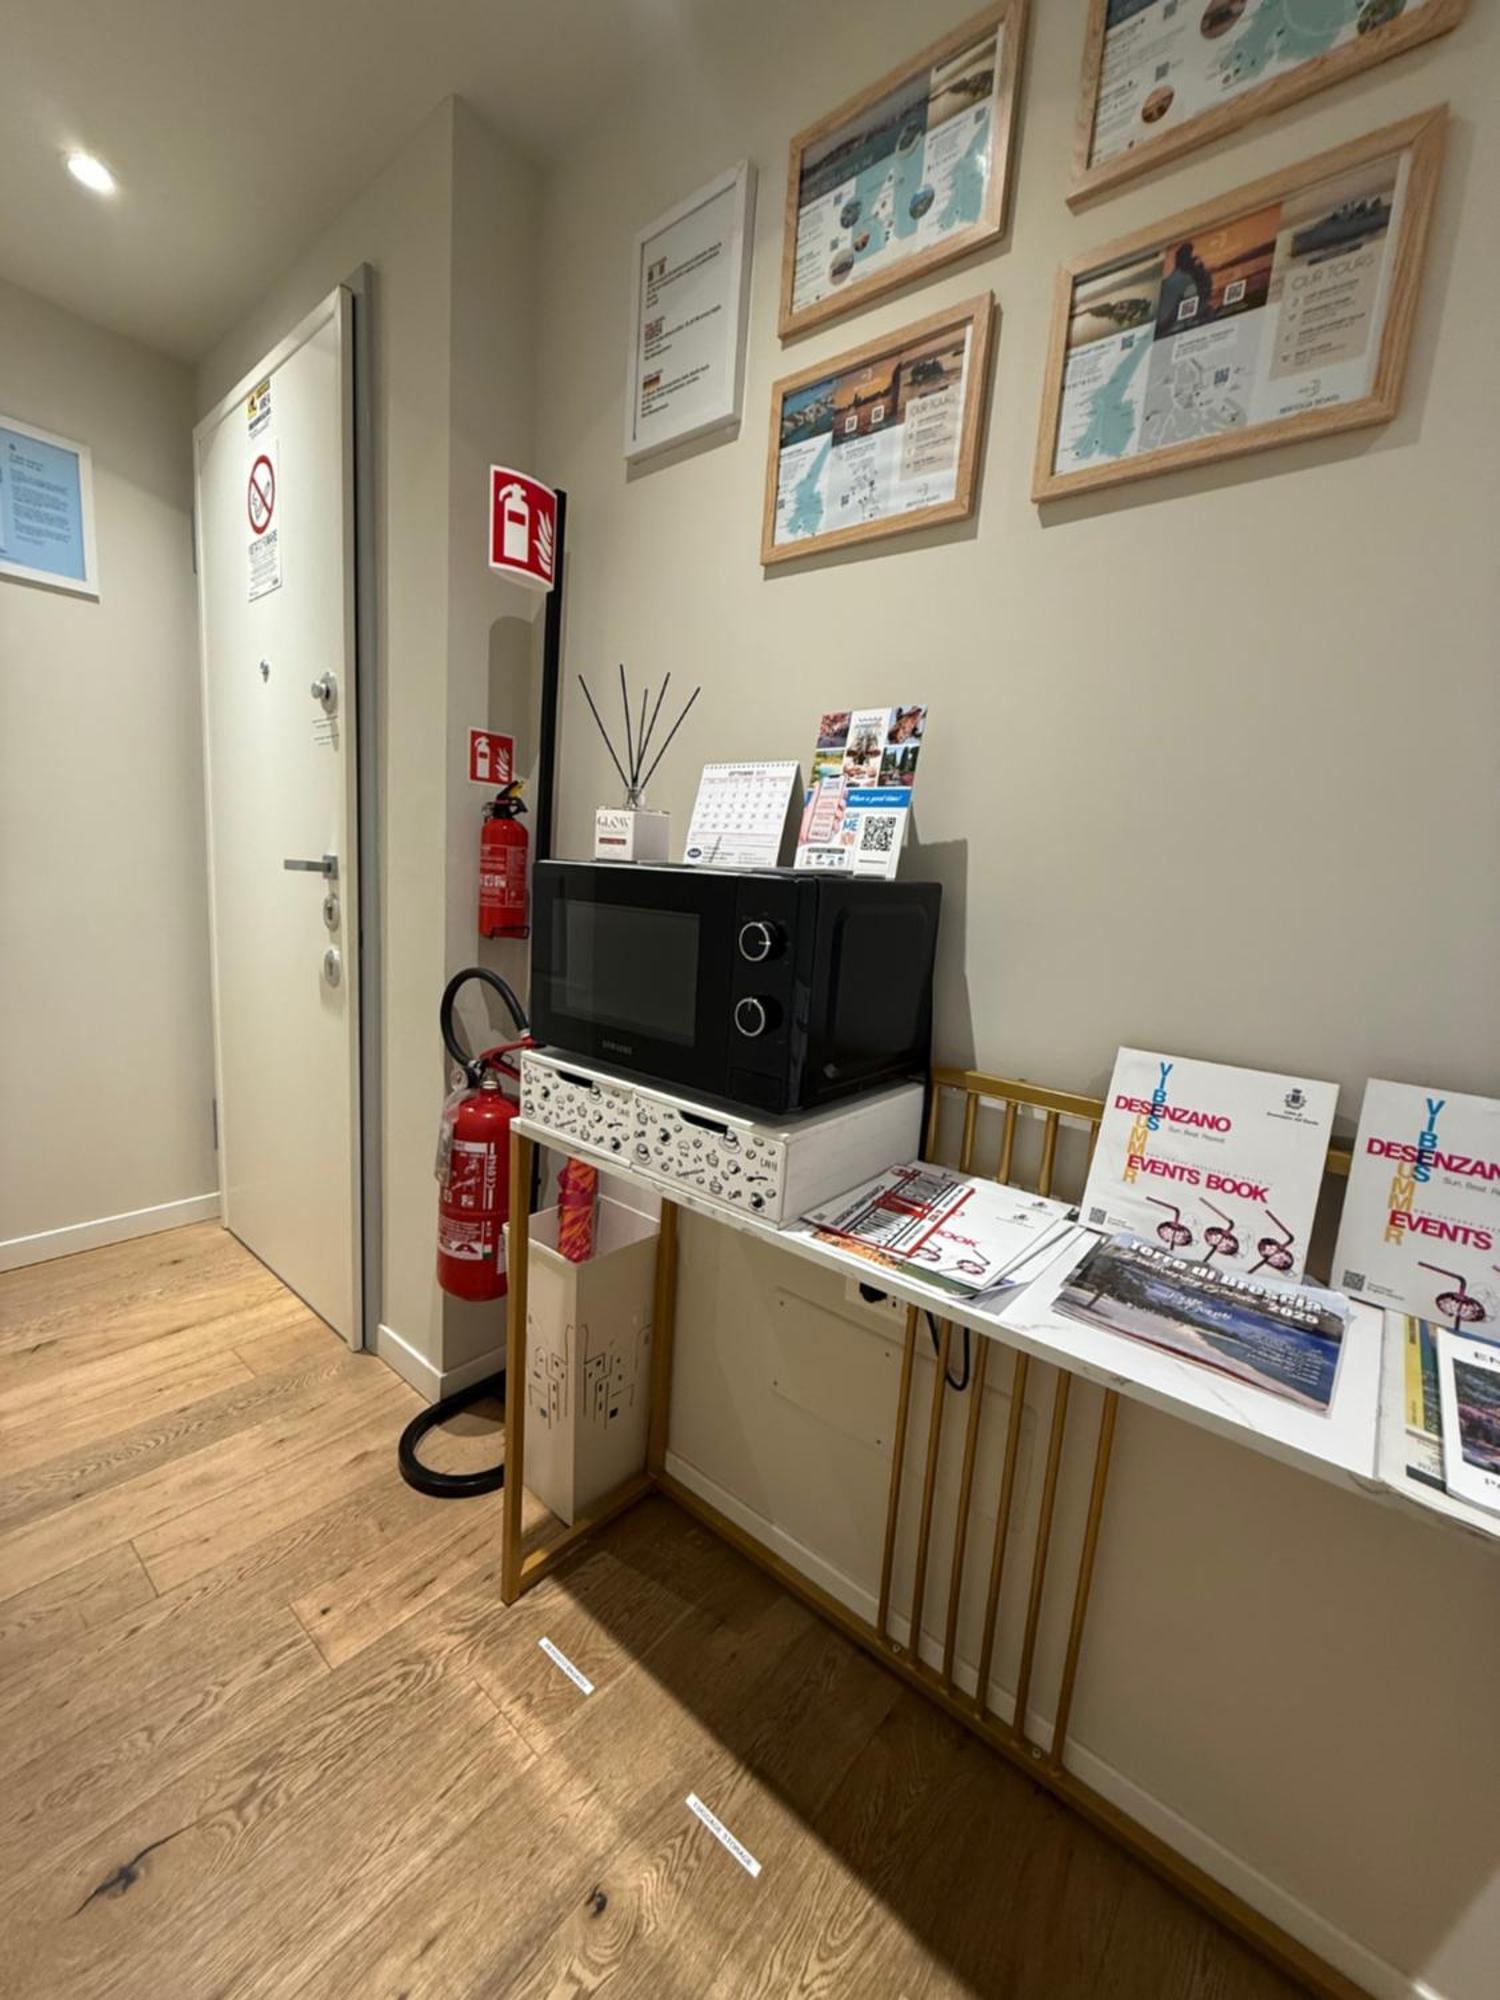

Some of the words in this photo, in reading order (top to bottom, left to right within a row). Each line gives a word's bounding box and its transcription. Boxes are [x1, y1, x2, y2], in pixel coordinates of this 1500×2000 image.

[1115, 1095, 1232, 1133] DESENZANO
[1127, 1154, 1201, 1186] EVENTS
[1205, 1173, 1269, 1204] BOOK
[1388, 1210, 1493, 1251] EVENTS
[1265, 1304, 1319, 1325] 2025
